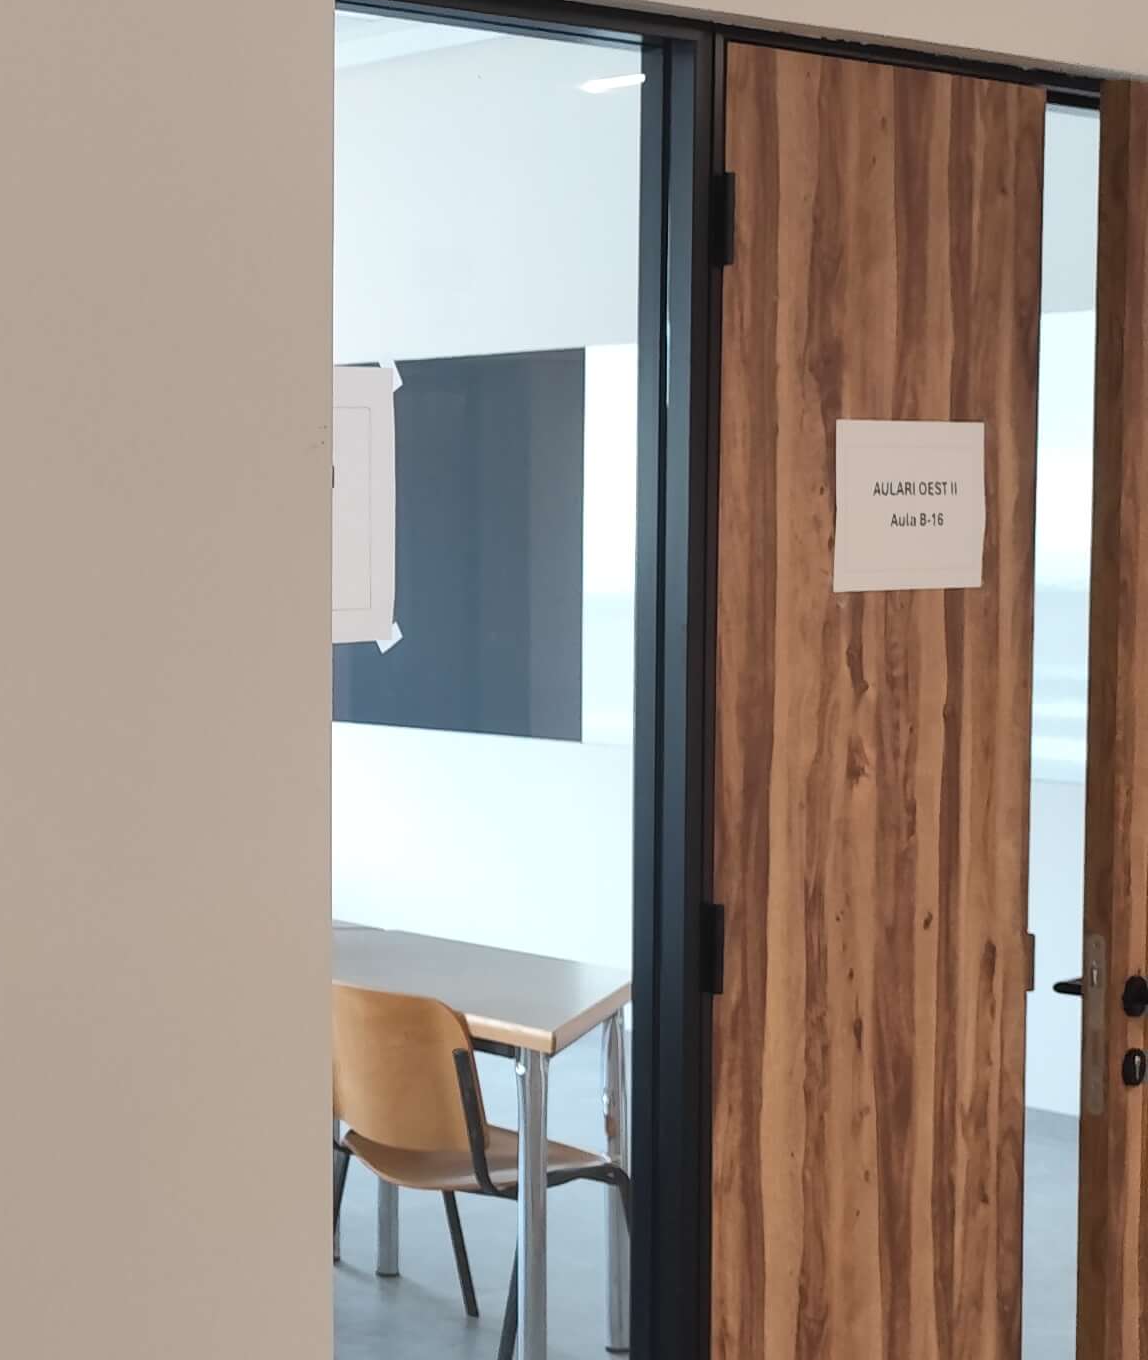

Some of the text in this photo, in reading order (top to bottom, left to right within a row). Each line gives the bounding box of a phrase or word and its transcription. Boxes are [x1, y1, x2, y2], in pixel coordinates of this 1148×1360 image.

[873, 481, 957, 496] AULARI OEST II
[891, 512, 944, 527] Aula B-16
